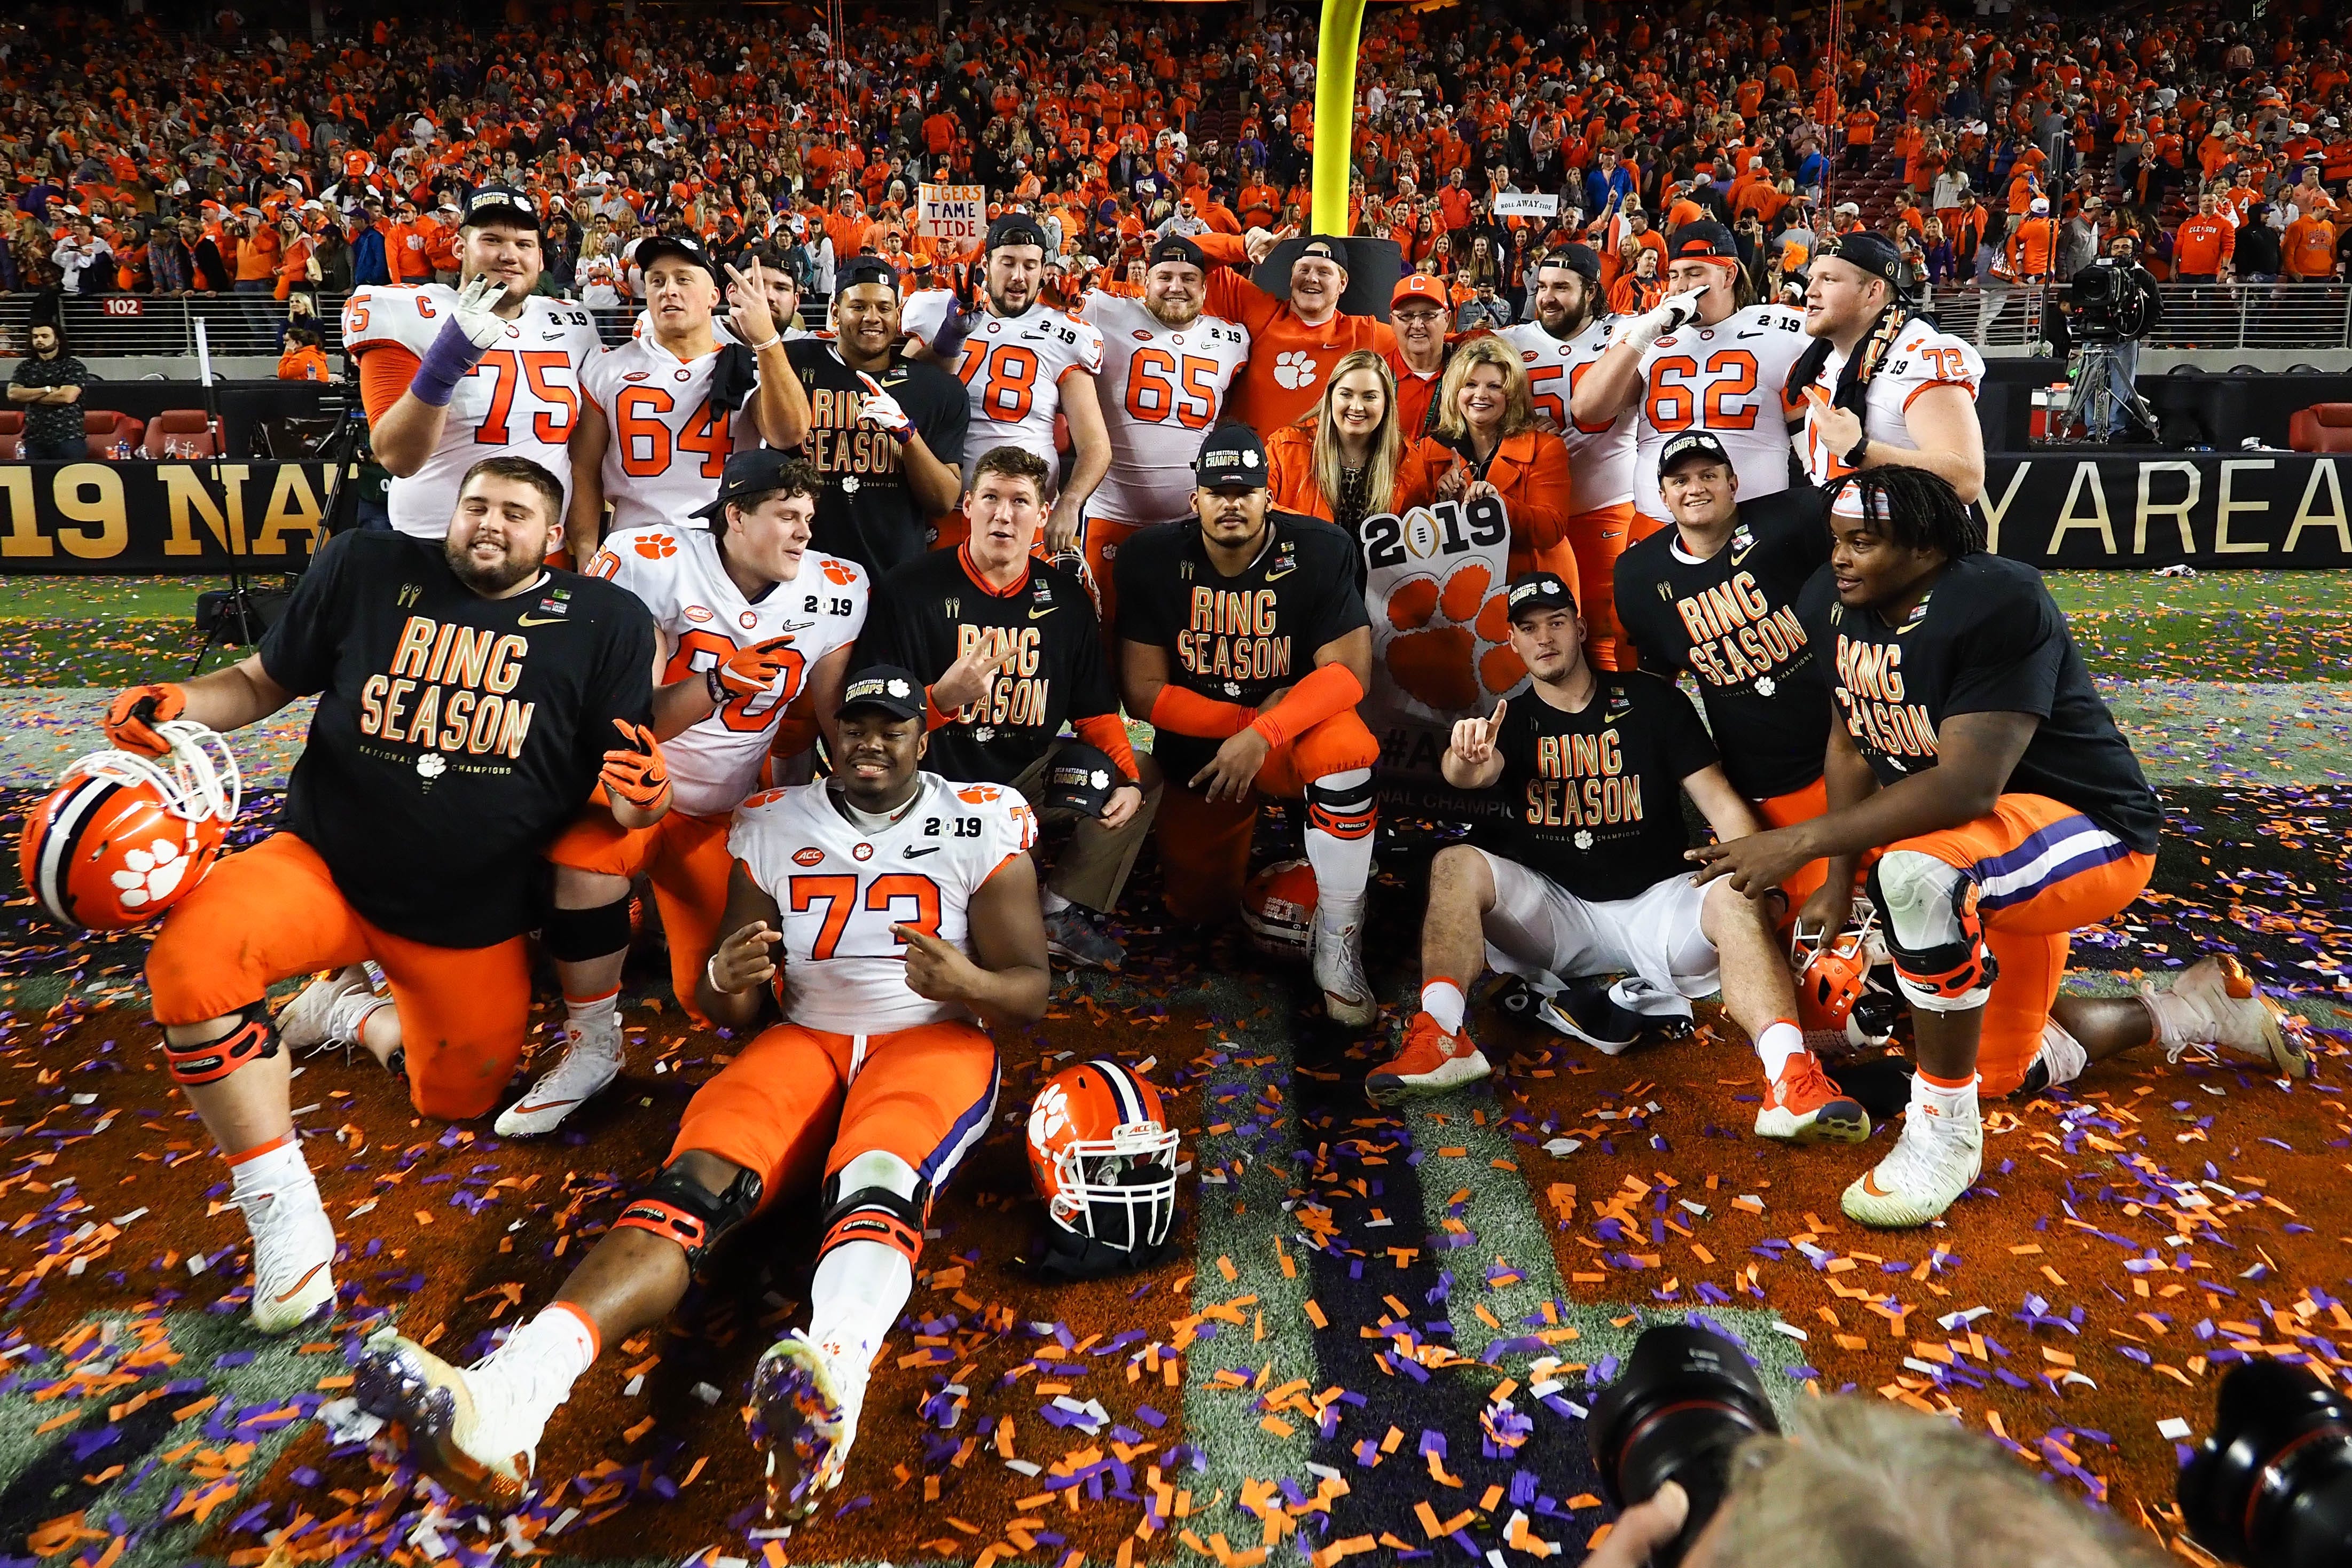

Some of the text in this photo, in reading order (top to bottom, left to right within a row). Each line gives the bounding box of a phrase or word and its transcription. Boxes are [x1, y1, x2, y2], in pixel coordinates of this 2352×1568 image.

[2105, 103, 2117, 117] 42
[472, 195, 509, 210] CHAMPS
[921, 185, 981, 202] TIGERS
[1516, 200, 1540, 208] AWAY
[2239, 197, 2249, 214] 4
[928, 202, 976, 218] TAME
[932, 220, 975, 237] TIDE
[1409, 276, 1426, 291] C
[107, 300, 138, 315] 102
[415, 295, 436, 319] C
[1658, 337, 1675, 346] ACC
[1922, 348, 1969, 379] 72
[957, 338, 1038, 424] 78
[1125, 347, 1219, 430] 65
[1645, 349, 1759, 433] 62
[463, 349, 577, 445] 75
[812, 388, 884, 431] RIN
[616, 385, 734, 479] 64
[801, 429, 903, 474] SEASON
[1205, 455, 1240, 468] CHAMPS
[1664, 440, 1697, 460] CHAMPS
[0, 462, 128, 559] 19
[2047, 458, 2352, 555] AREA
[1509, 586, 1538, 607] CHAMPS
[1677, 570, 1768, 645] RING
[688, 608, 709, 617] ACC
[1190, 585, 1276, 636] RING
[390, 615, 529, 695] RING
[1178, 629, 1290, 680] SEASON
[1689, 604, 1808, 687] SEASON
[1776, 652, 1813, 682] CHAMPIONS
[1836, 633, 1906, 703] RING
[845, 684, 884, 703] CHAMPS
[857, 678, 885, 688] NATIONAL
[361, 674, 535, 759] SEASON
[359, 745, 512, 775] NATIONAL CHAMPIONS
[1538, 728, 1622, 779] RING
[1054, 772, 1088, 786] CHAMPS
[1064, 767, 1088, 776] NATIONAL
[1526, 774, 1643, 826] SEASON
[1596, 829, 1640, 842] CHAMPIONS
[797, 850, 821, 860] ACC
[788, 873, 942, 961] 73
[1130, 1124, 1150, 1133] ACC
